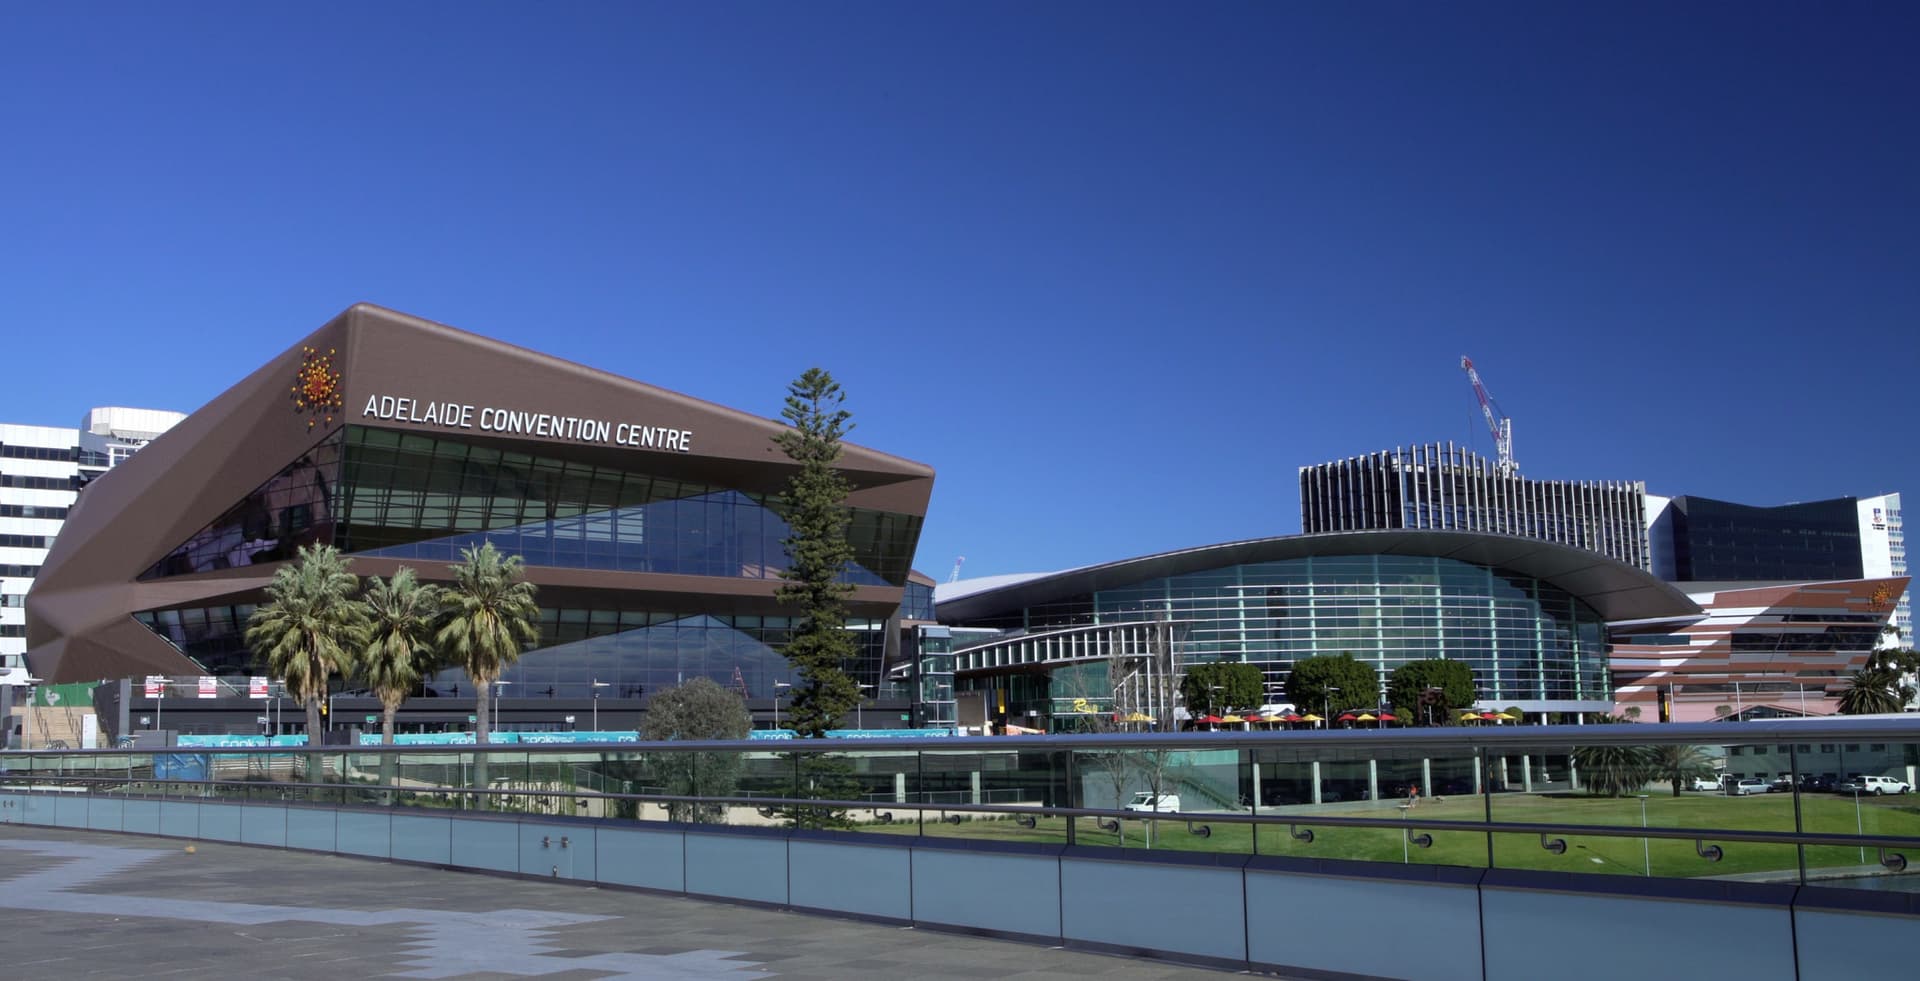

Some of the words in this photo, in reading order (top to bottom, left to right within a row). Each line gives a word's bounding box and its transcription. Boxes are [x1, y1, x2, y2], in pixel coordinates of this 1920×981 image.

[362, 394, 475, 428] ADELAIDE
[480, 407, 610, 443] CONVENTION
[616, 423, 692, 451] CENTRE
